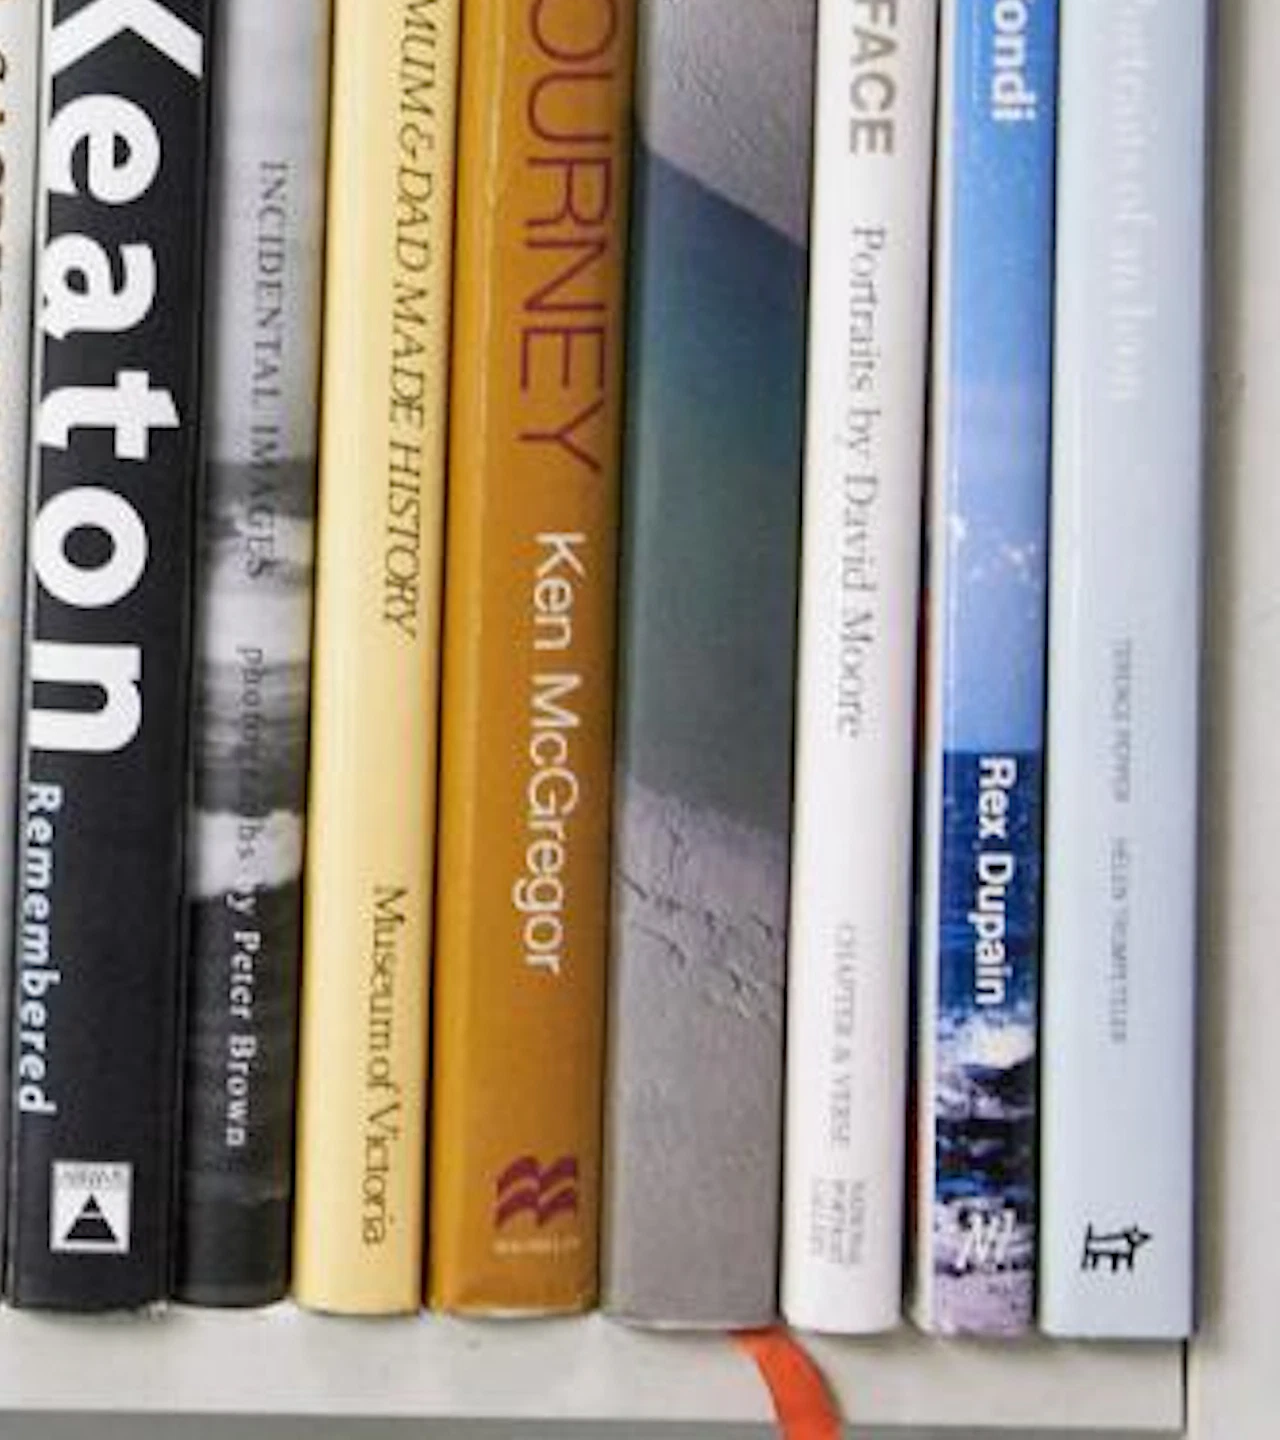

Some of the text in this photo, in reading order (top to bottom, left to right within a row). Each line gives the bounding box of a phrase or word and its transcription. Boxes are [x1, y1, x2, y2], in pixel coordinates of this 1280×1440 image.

[397, 165, 432, 271] DAD
[244, 160, 289, 580] INCIDENTAL IMAGES
[388, 280, 428, 428] MADE
[383, 442, 424, 637] HISTORY
[836, 226, 886, 738] Portraits by David Moore
[513, 531, 587, 974] Ken McGregor
[19, 782, 65, 1113] Remembered
[232, 931, 261, 1019] Peter
[974, 757, 1017, 1007] Rex Dupain
[226, 1035, 257, 1148] Brown
[363, 885, 409, 1247] Museum of Victoria
